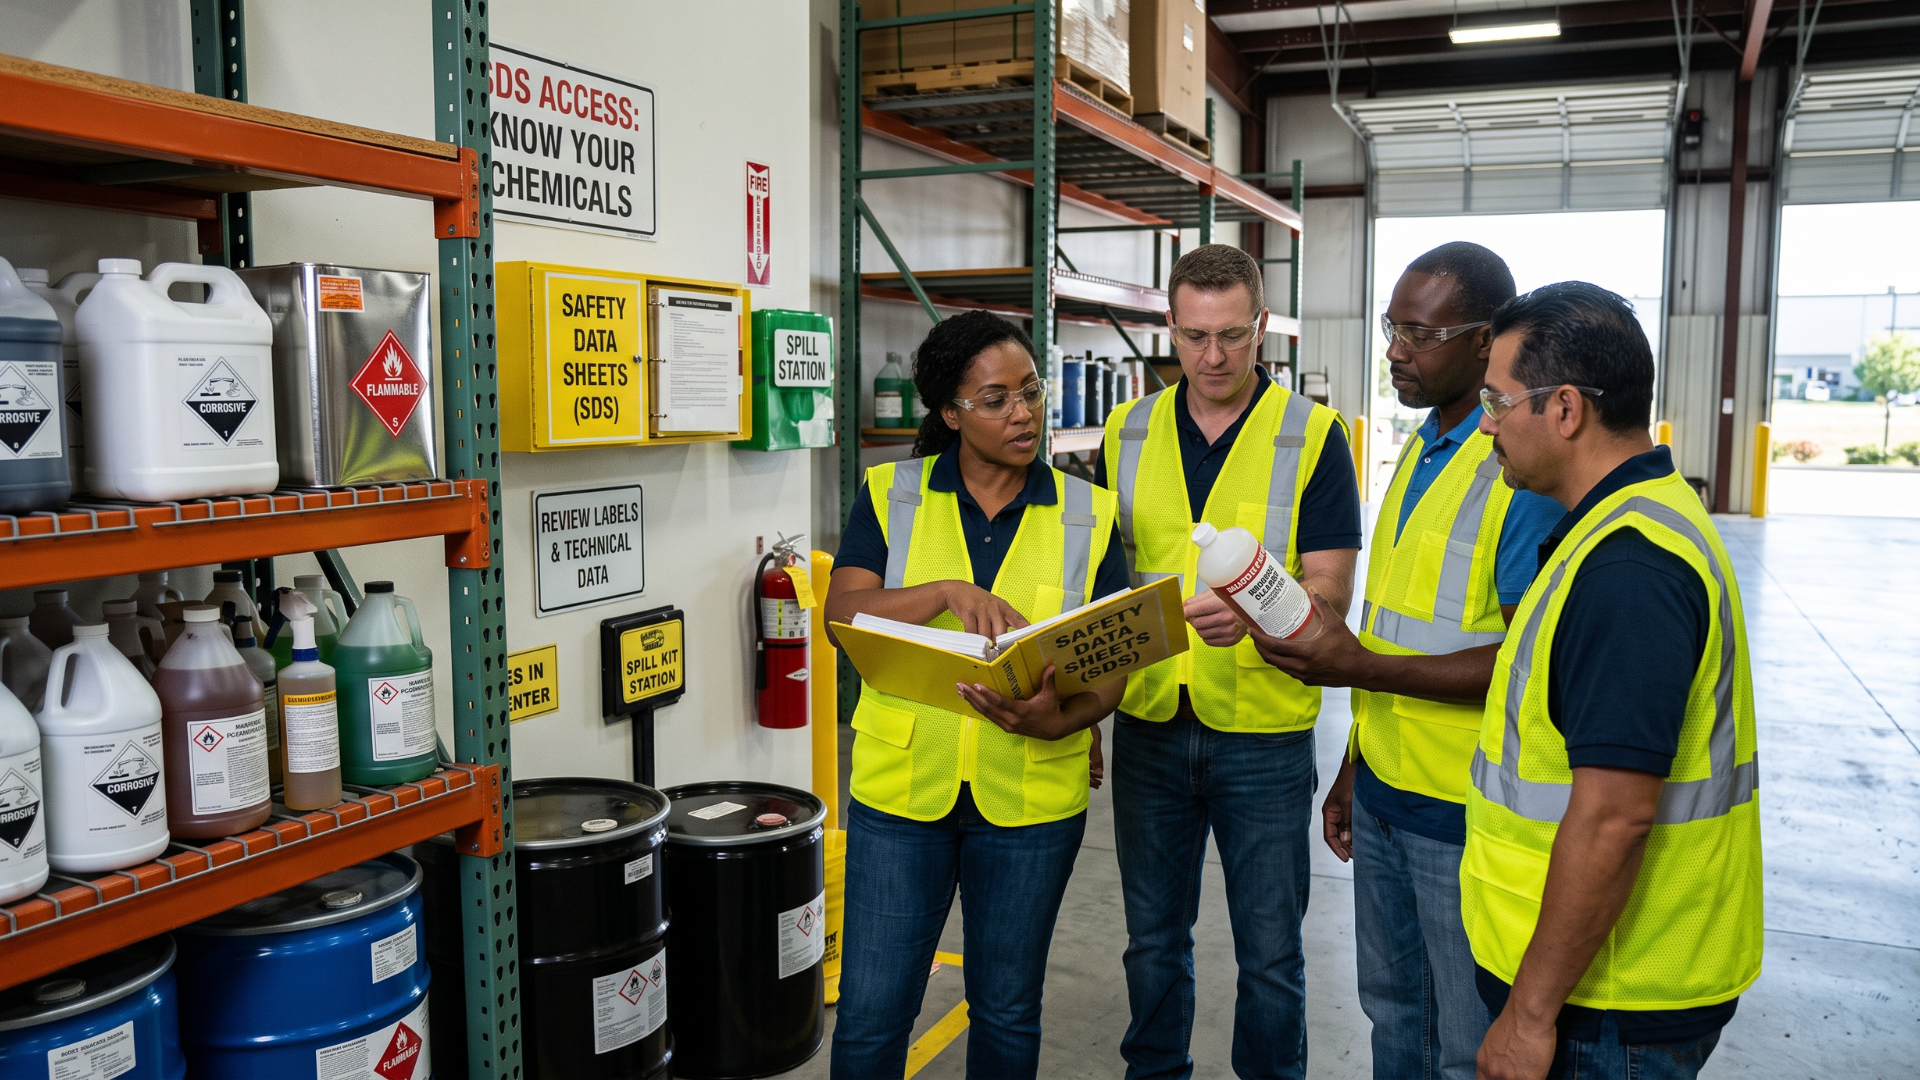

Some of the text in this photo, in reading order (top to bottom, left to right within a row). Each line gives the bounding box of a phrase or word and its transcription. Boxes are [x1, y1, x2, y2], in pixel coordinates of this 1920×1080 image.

[539, 75, 639, 132] ACCESS:
[570, 129, 636, 175] YOUR
[491, 160, 632, 218] CHEMICALS
[750, 174, 768, 193] FIRE
[562, 292, 626, 320] SAFETY
[574, 328, 618, 352] DATA
[786, 334, 819, 356] SPILL
[563, 362, 628, 386] SHEETS
[778, 359, 826, 381] STATION
[366, 383, 419, 397] FLAMMABLE
[199, 402, 247, 413] CORROSIVE
[574, 395, 619, 427] (SDS)
[541, 502, 639, 533] REVIEW LABELS
[551, 532, 632, 563] & TECHNICAL
[578, 564, 609, 589] DATA
[1055, 602, 1144, 649] SAFETY
[1064, 631, 1151, 675] SHEETS
[1073, 625, 1134, 657] DATA
[528, 662, 544, 682] IN
[626, 648, 679, 676] SPILL KIT
[1080, 651, 1140, 683] (SDS)
[629, 669, 676, 695] STATION
[107, 775, 155, 794] CORROSIVE
